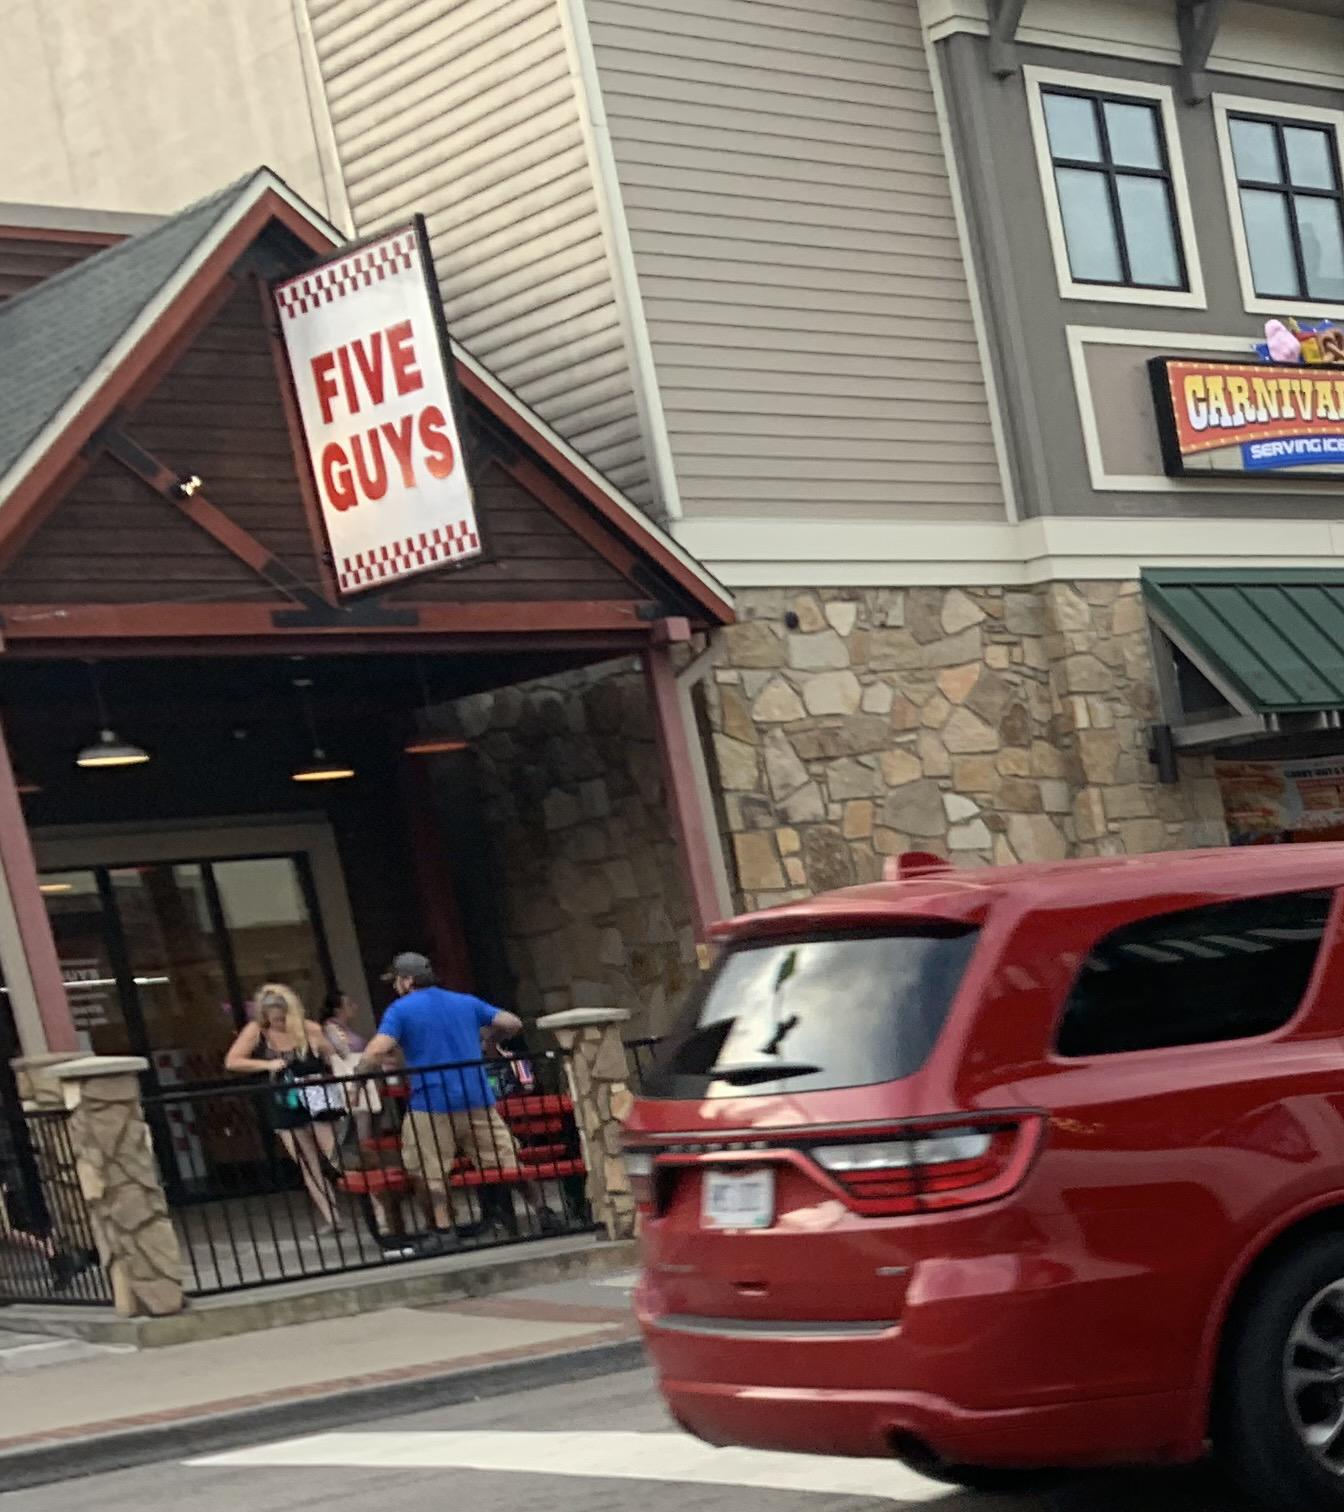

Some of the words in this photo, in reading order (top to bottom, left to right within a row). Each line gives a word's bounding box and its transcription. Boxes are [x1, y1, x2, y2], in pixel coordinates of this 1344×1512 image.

[310, 319, 424, 425] FIVE
[321, 406, 455, 512] GUYS
[1251, 438, 1320, 459] SERVING
